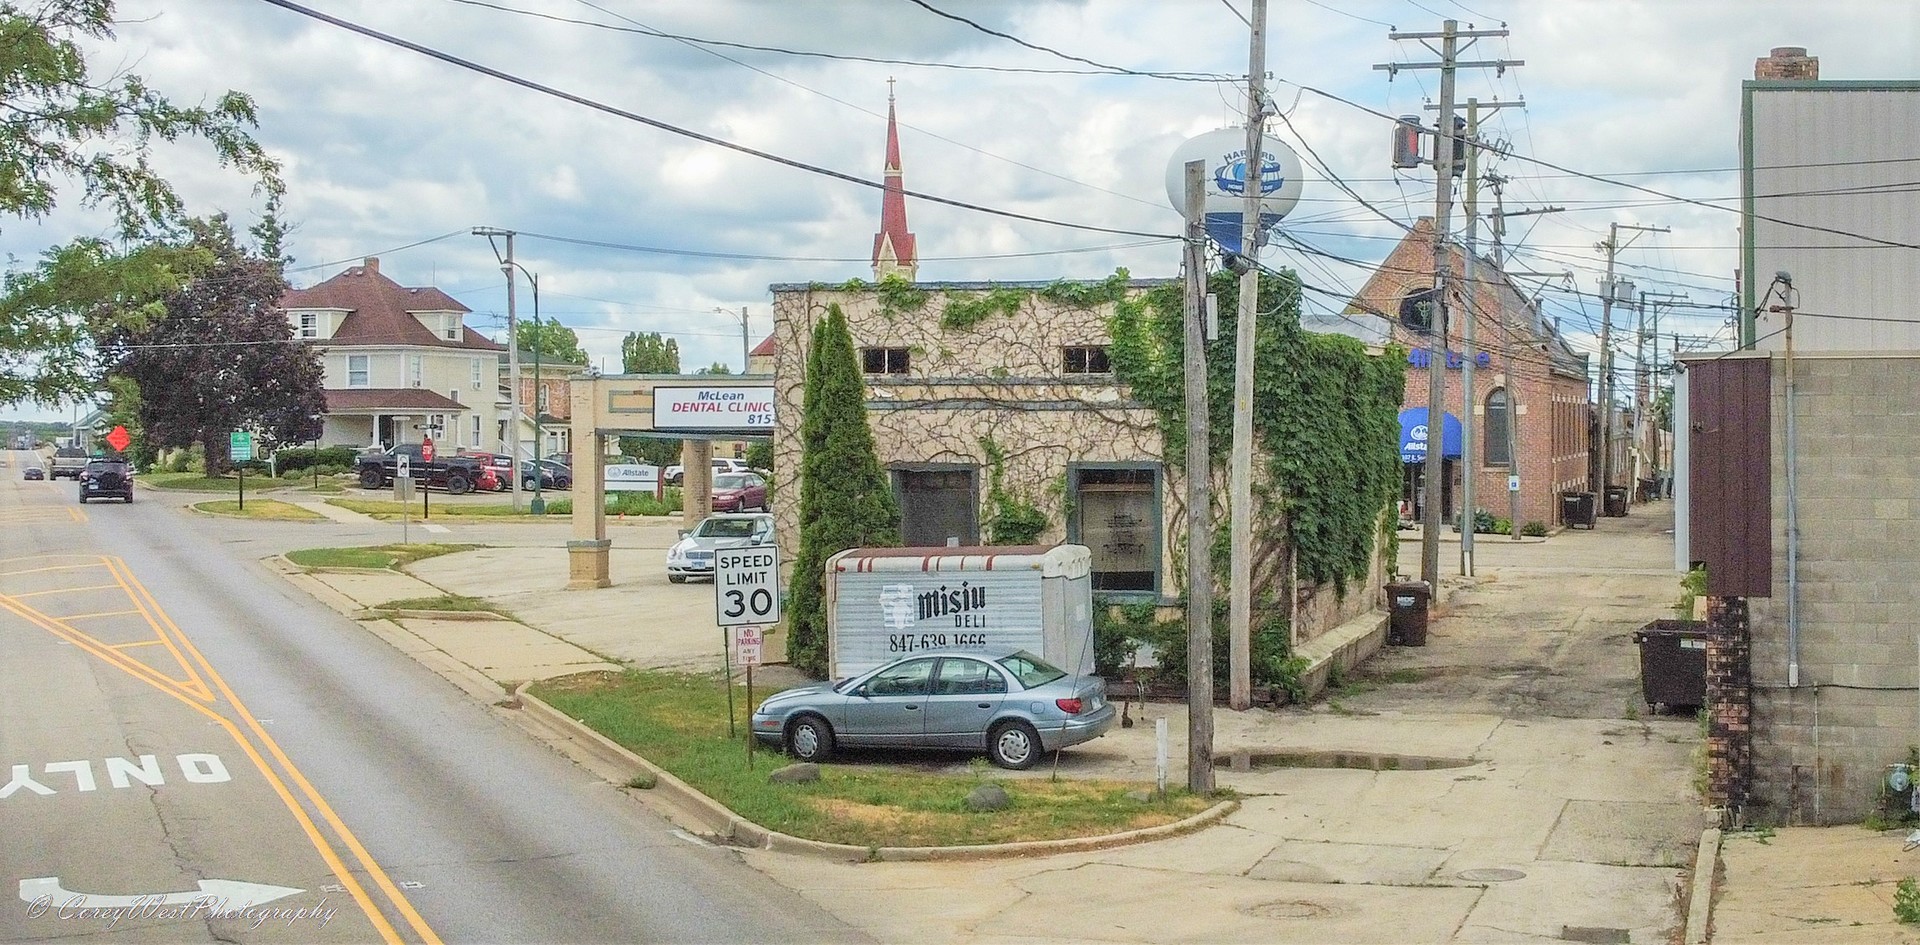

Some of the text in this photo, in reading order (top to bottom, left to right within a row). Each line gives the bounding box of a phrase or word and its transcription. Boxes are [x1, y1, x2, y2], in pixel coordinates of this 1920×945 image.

[1223, 150, 1275, 164] HARRD
[1407, 348, 1490, 369] Alltae
[697, 391, 744, 401] McLean
[671, 402, 772, 413] DENTAL CLINIC
[1404, 442, 1427, 451] Allsta
[622, 469, 649, 477] Allstate
[720, 555, 773, 569] SPEED
[726, 571, 767, 585] LIMIT
[724, 588, 772, 617] 30
[955, 615, 985, 628] DELI
[743, 629, 753, 638] NO
[889, 634, 986, 652] 847-6391666
[0, 753, 231, 799] ONLY
